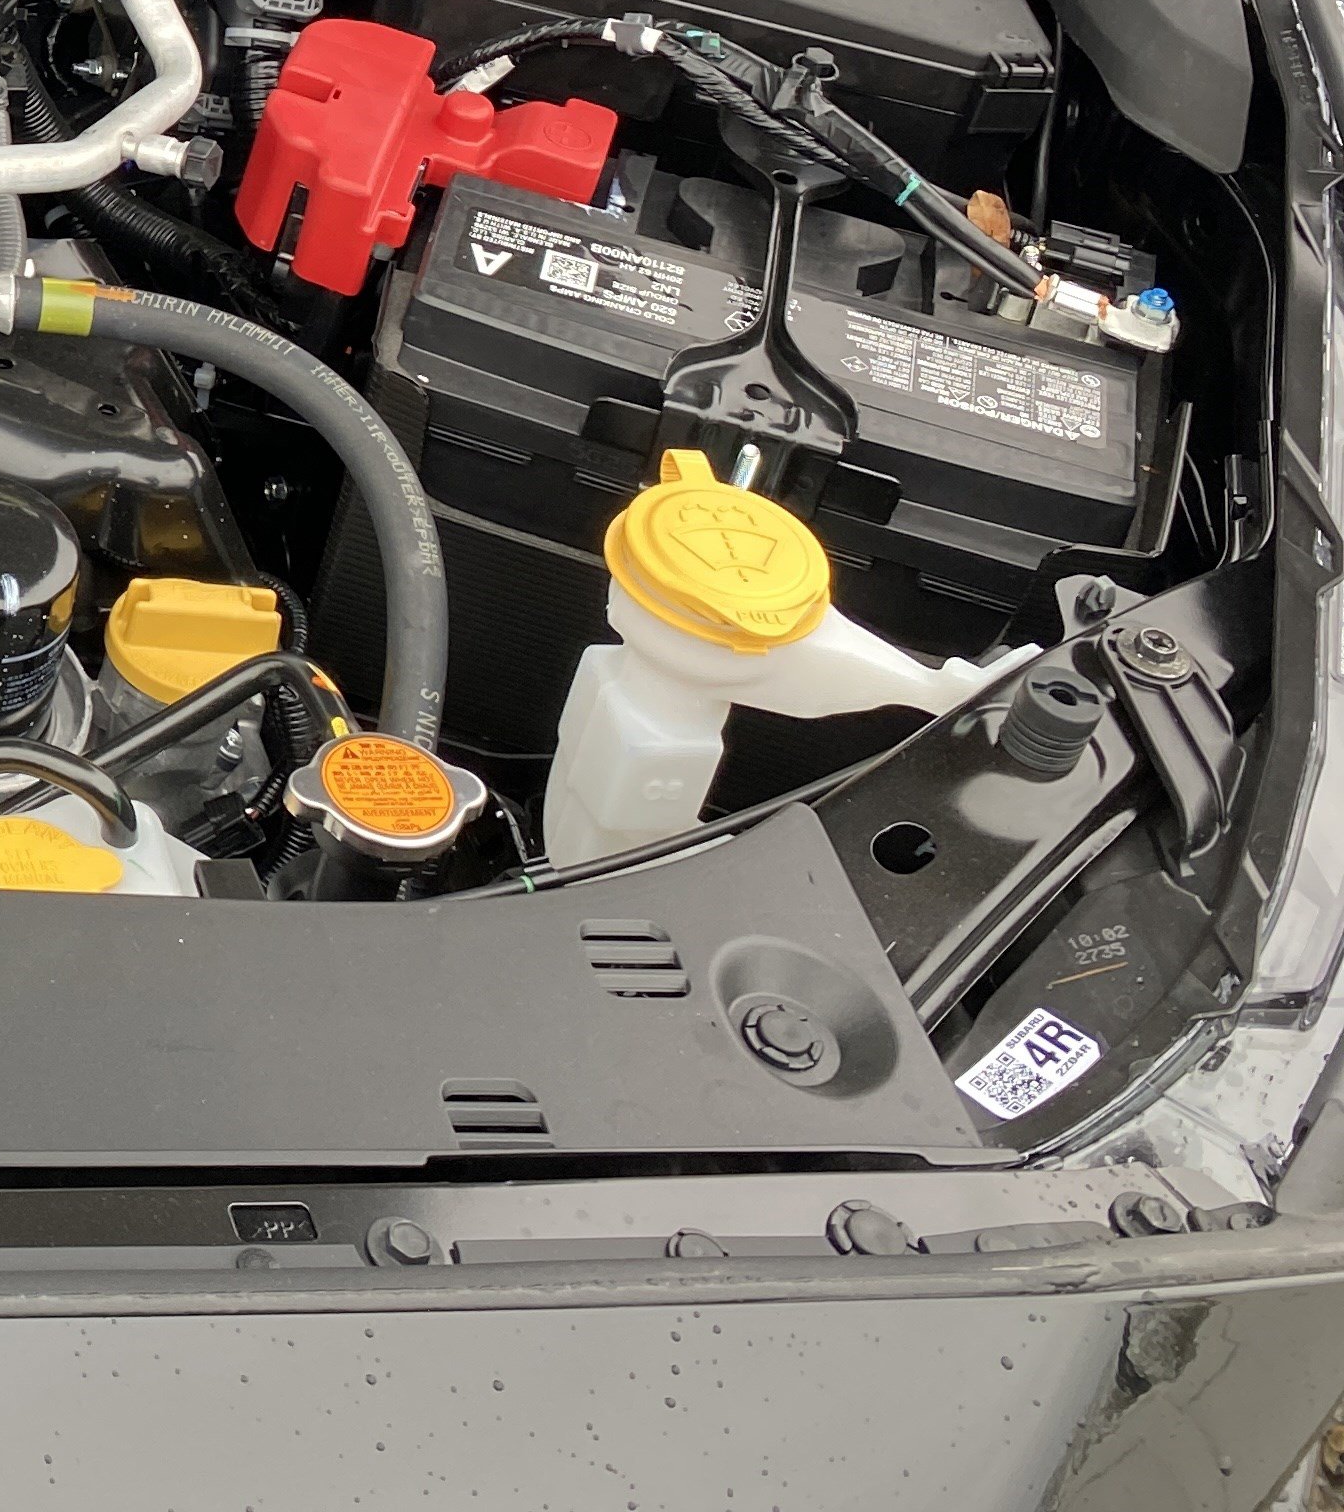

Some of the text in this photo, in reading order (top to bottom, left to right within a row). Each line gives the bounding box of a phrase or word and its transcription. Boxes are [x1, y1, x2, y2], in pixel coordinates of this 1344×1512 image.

[619, 261, 635, 272] AH
[602, 288, 676, 316] 620 AMPS
[612, 280, 678, 305] GROUP SIZE
[650, 280, 680, 296] LN2
[549, 283, 674, 325] COLD CRANKING AMPS
[109, 285, 297, 355] CHIRIN HYLAMMIT
[937, 394, 1063, 437] DANGER/POISON
[736, 609, 788, 626] PULL
[1075, 942, 1126, 965] 2735
[1005, 1014, 1045, 1049] SUBARU
[1024, 1020, 1083, 1068] 4R
